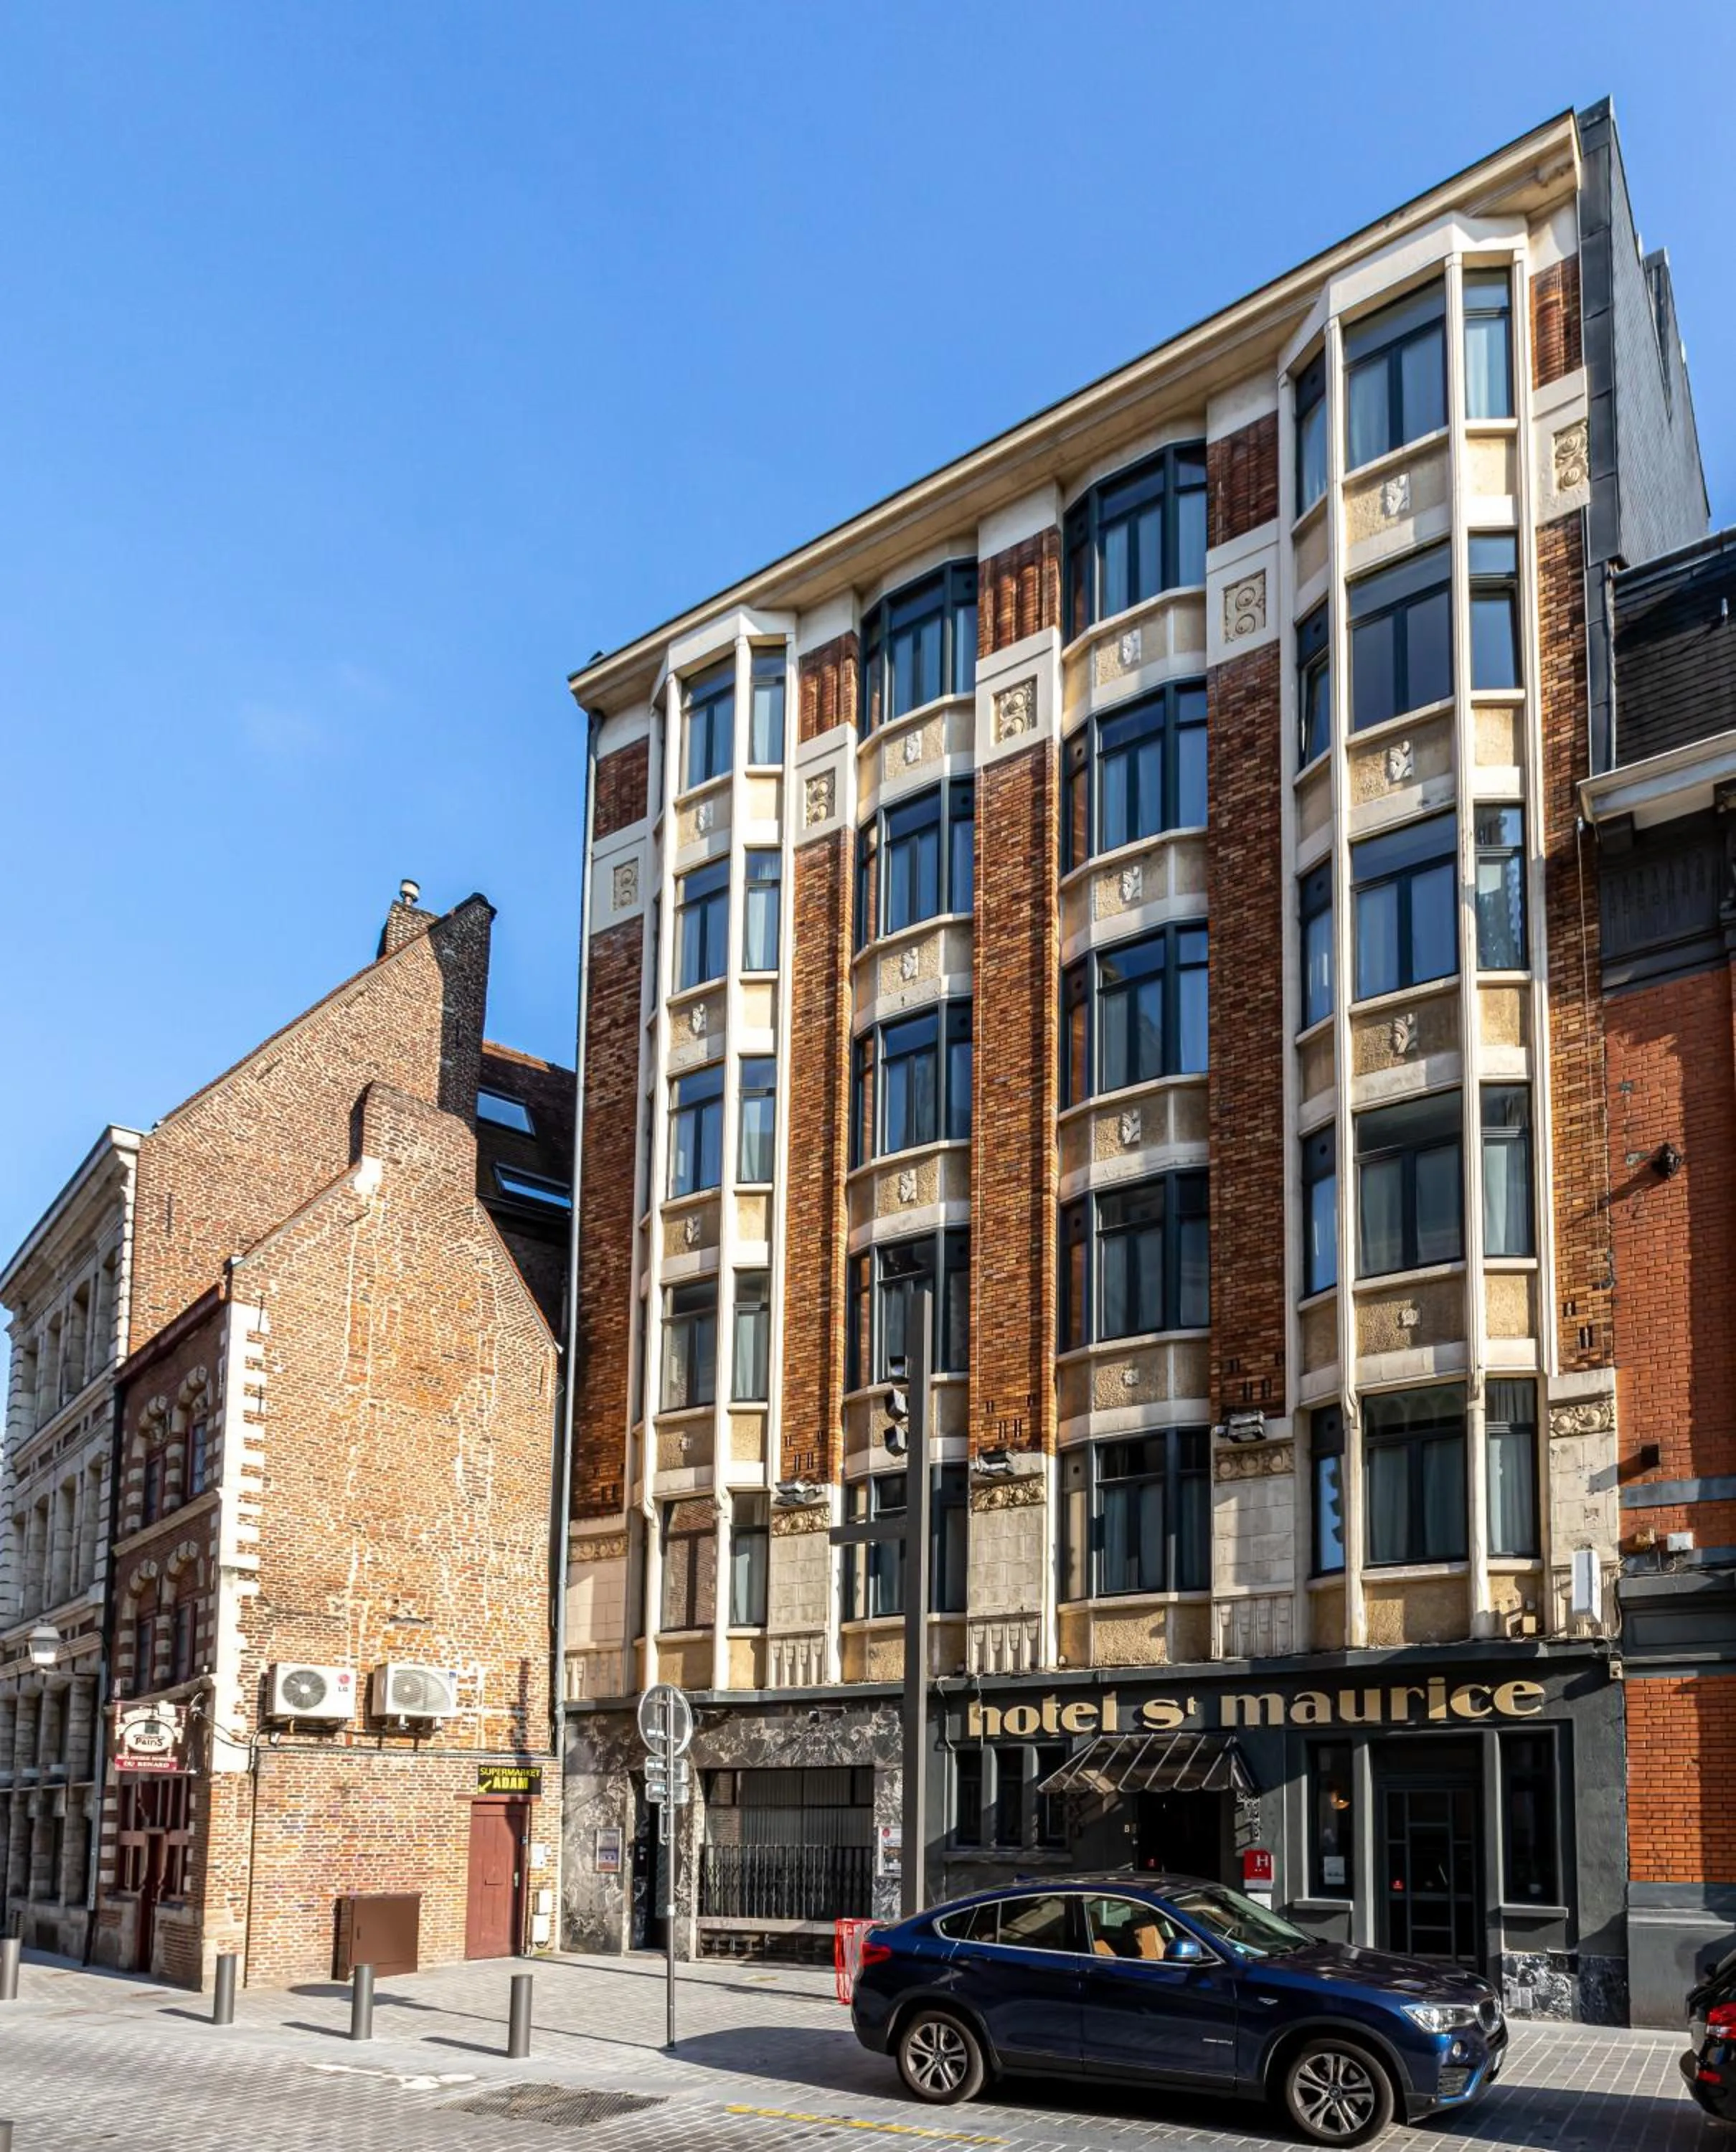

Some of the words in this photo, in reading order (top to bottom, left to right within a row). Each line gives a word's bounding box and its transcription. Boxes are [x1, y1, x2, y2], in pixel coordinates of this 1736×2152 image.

[968, 1690, 1118, 1737] hotel
[1220, 1676, 1546, 1727] maurice
[479, 1767, 541, 1778] SUPERMARKET
[492, 1776, 529, 1789] ADAM
[1256, 1854, 1269, 1867] H
